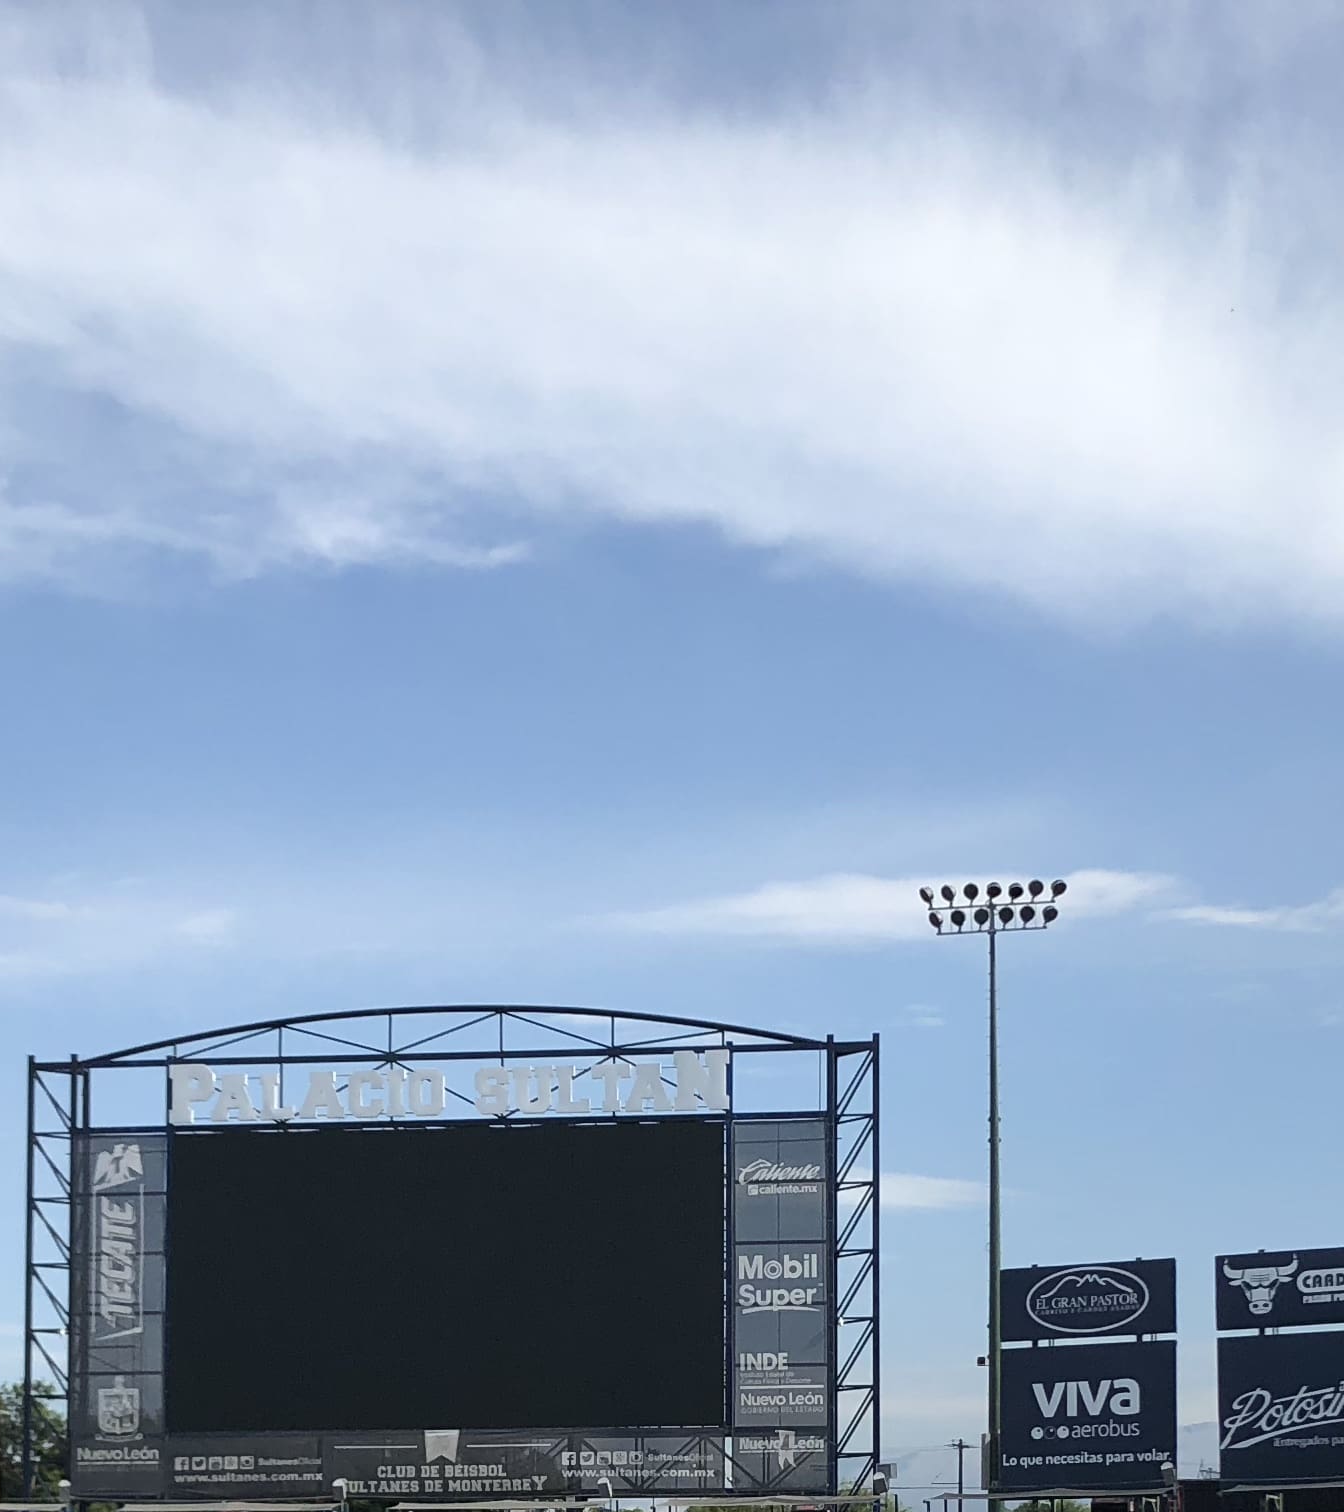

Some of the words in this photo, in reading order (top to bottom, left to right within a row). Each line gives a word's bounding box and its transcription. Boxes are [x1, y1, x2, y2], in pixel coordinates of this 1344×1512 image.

[168, 1063, 446, 1125] PALACIO
[474, 1050, 730, 1115] SULTAN
[739, 1158, 821, 1185] Caliente
[758, 1183, 818, 1195] caliente.mx
[100, 1196, 136, 1328] TECATE
[738, 1254, 818, 1280] Mobil
[739, 1284, 817, 1309] Super
[1036, 1298, 1050, 1310] EL
[1051, 1296, 1088, 1309] GRAN
[1090, 1293, 1138, 1307] PASTOR
[739, 1352, 789, 1371] INDE
[741, 1393, 787, 1406] Nuevo
[789, 1391, 824, 1405] León
[1071, 1420, 1140, 1438] aerobus
[789, 1436, 824, 1449] León
[77, 1448, 123, 1460] Nuevo
[124, 1446, 160, 1460] León
[1002, 1454, 1018, 1466] Lo
[1020, 1455, 1043, 1469] que
[1045, 1452, 1104, 1465] necesitas
[1106, 1453, 1135, 1465] para
[1137, 1449, 1172, 1462] volar.
[174, 1472, 323, 1483] www.sultanes.com.mx
[377, 1465, 416, 1478] CLUB
[421, 1465, 441, 1478] DE
[561, 1466, 715, 1478] www.sultanes.com.mx
[344, 1480, 419, 1494] ULTANES
[424, 1480, 443, 1493] DE
[448, 1475, 548, 1492] MONTERREY
